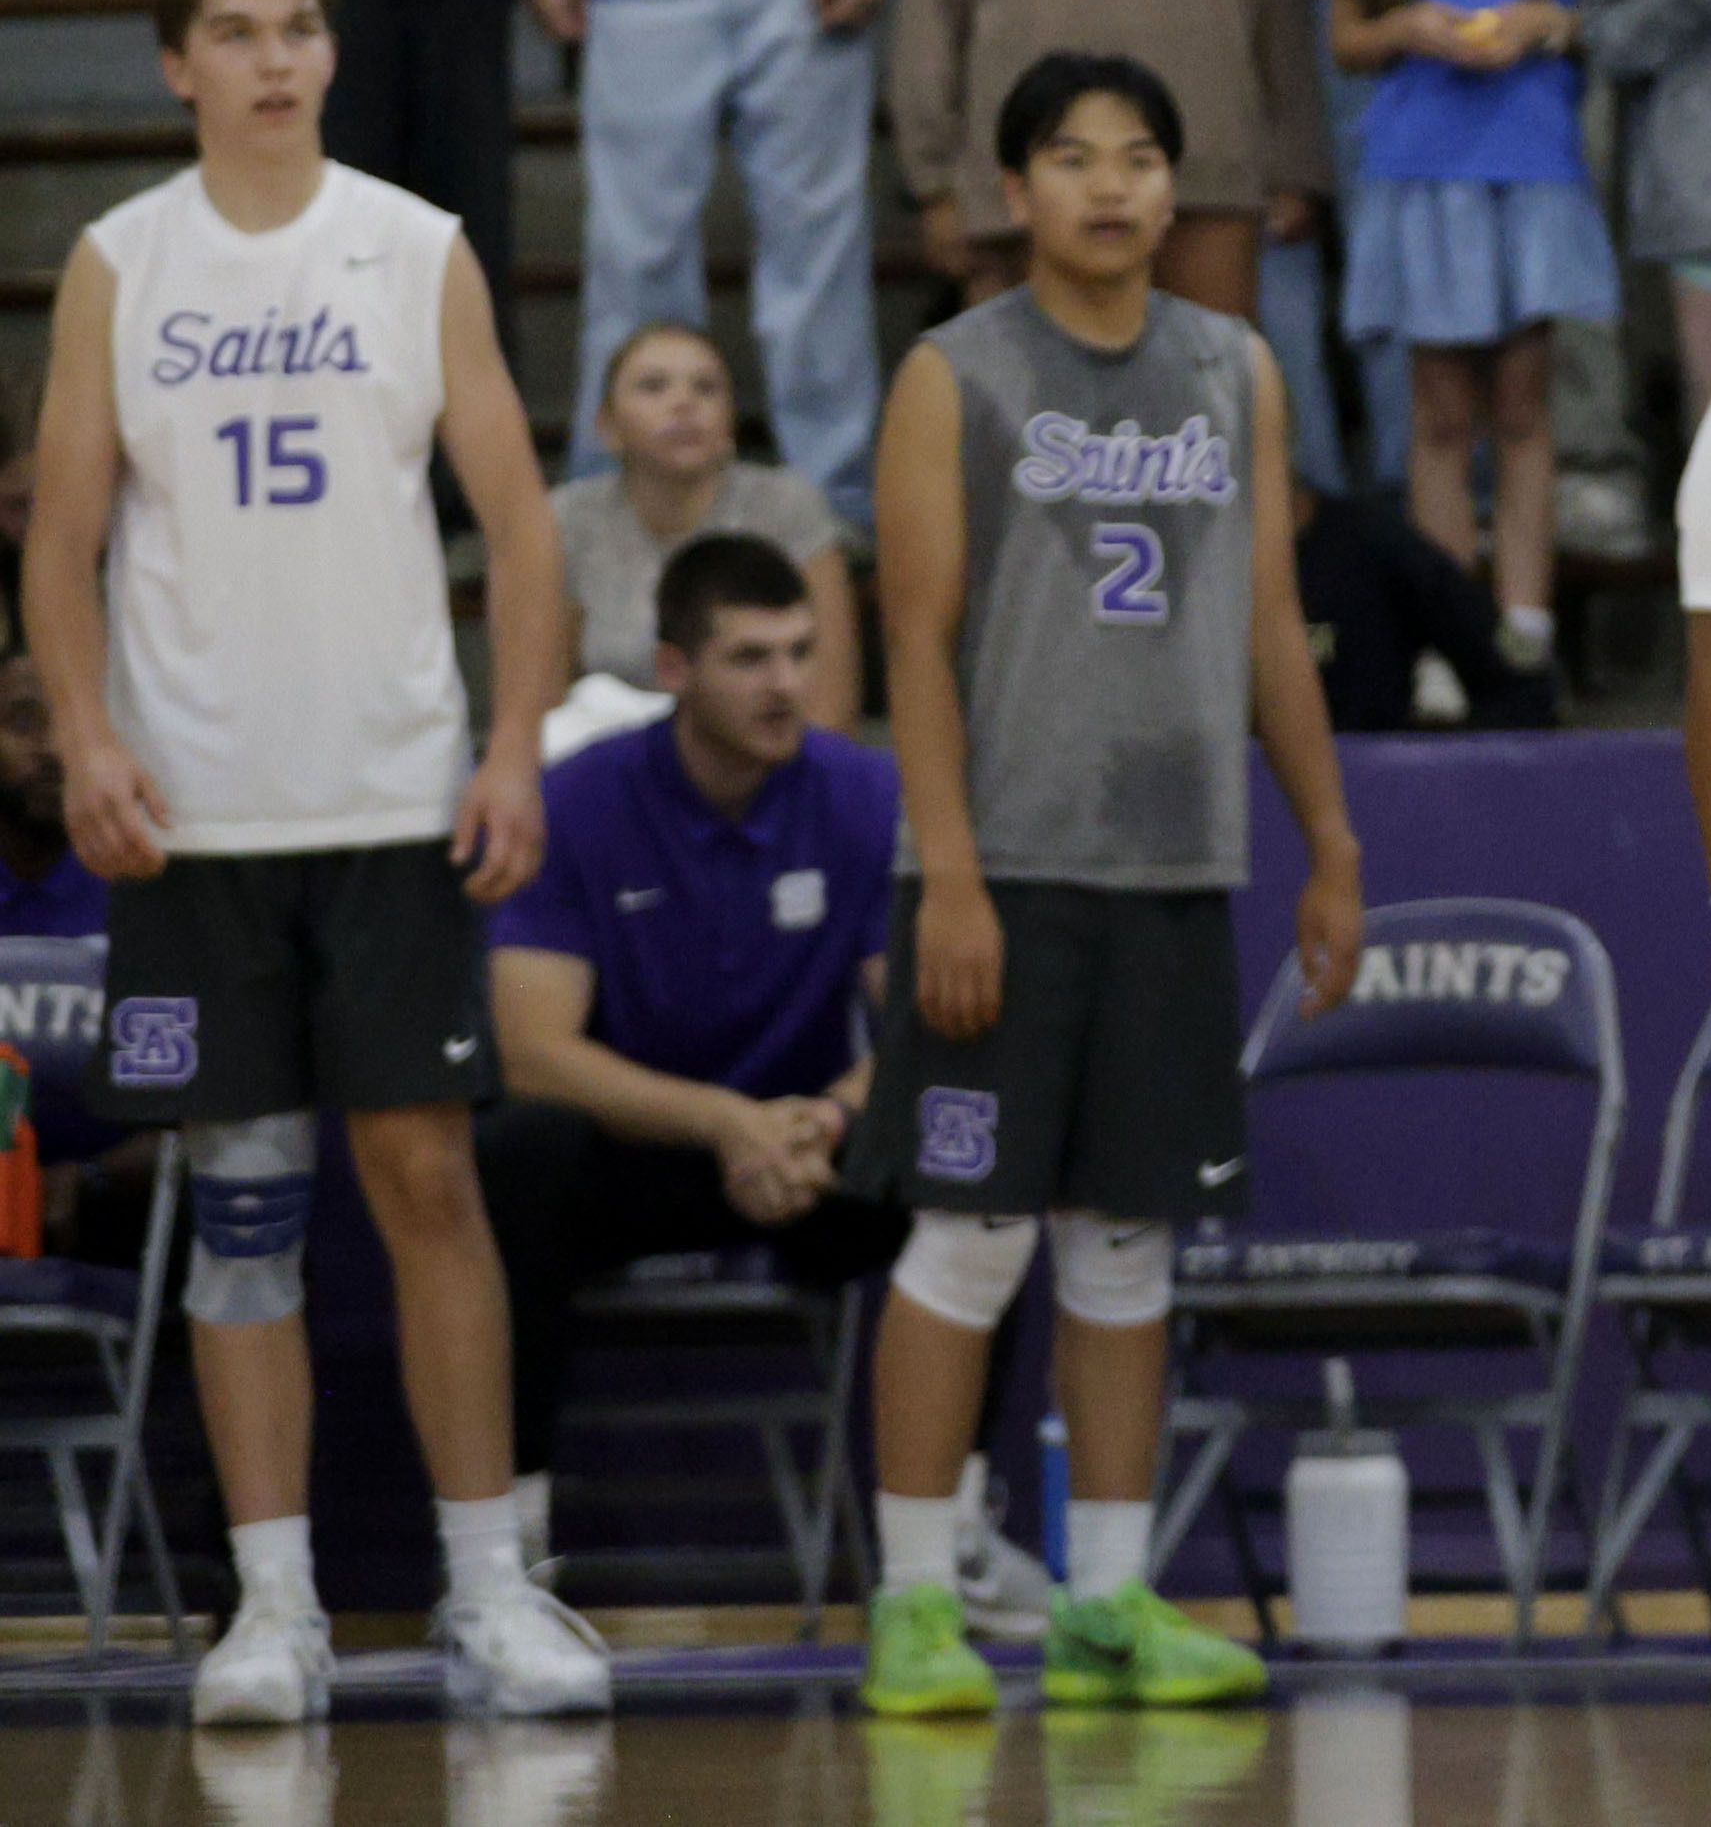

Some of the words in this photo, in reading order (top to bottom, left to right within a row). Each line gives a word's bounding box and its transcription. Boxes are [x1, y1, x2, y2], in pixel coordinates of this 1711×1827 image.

[152, 303, 369, 386] Saints
[216, 415, 328, 507] 15
[1013, 410, 1240, 505] Saints
[1091, 523, 1167, 624] 2
